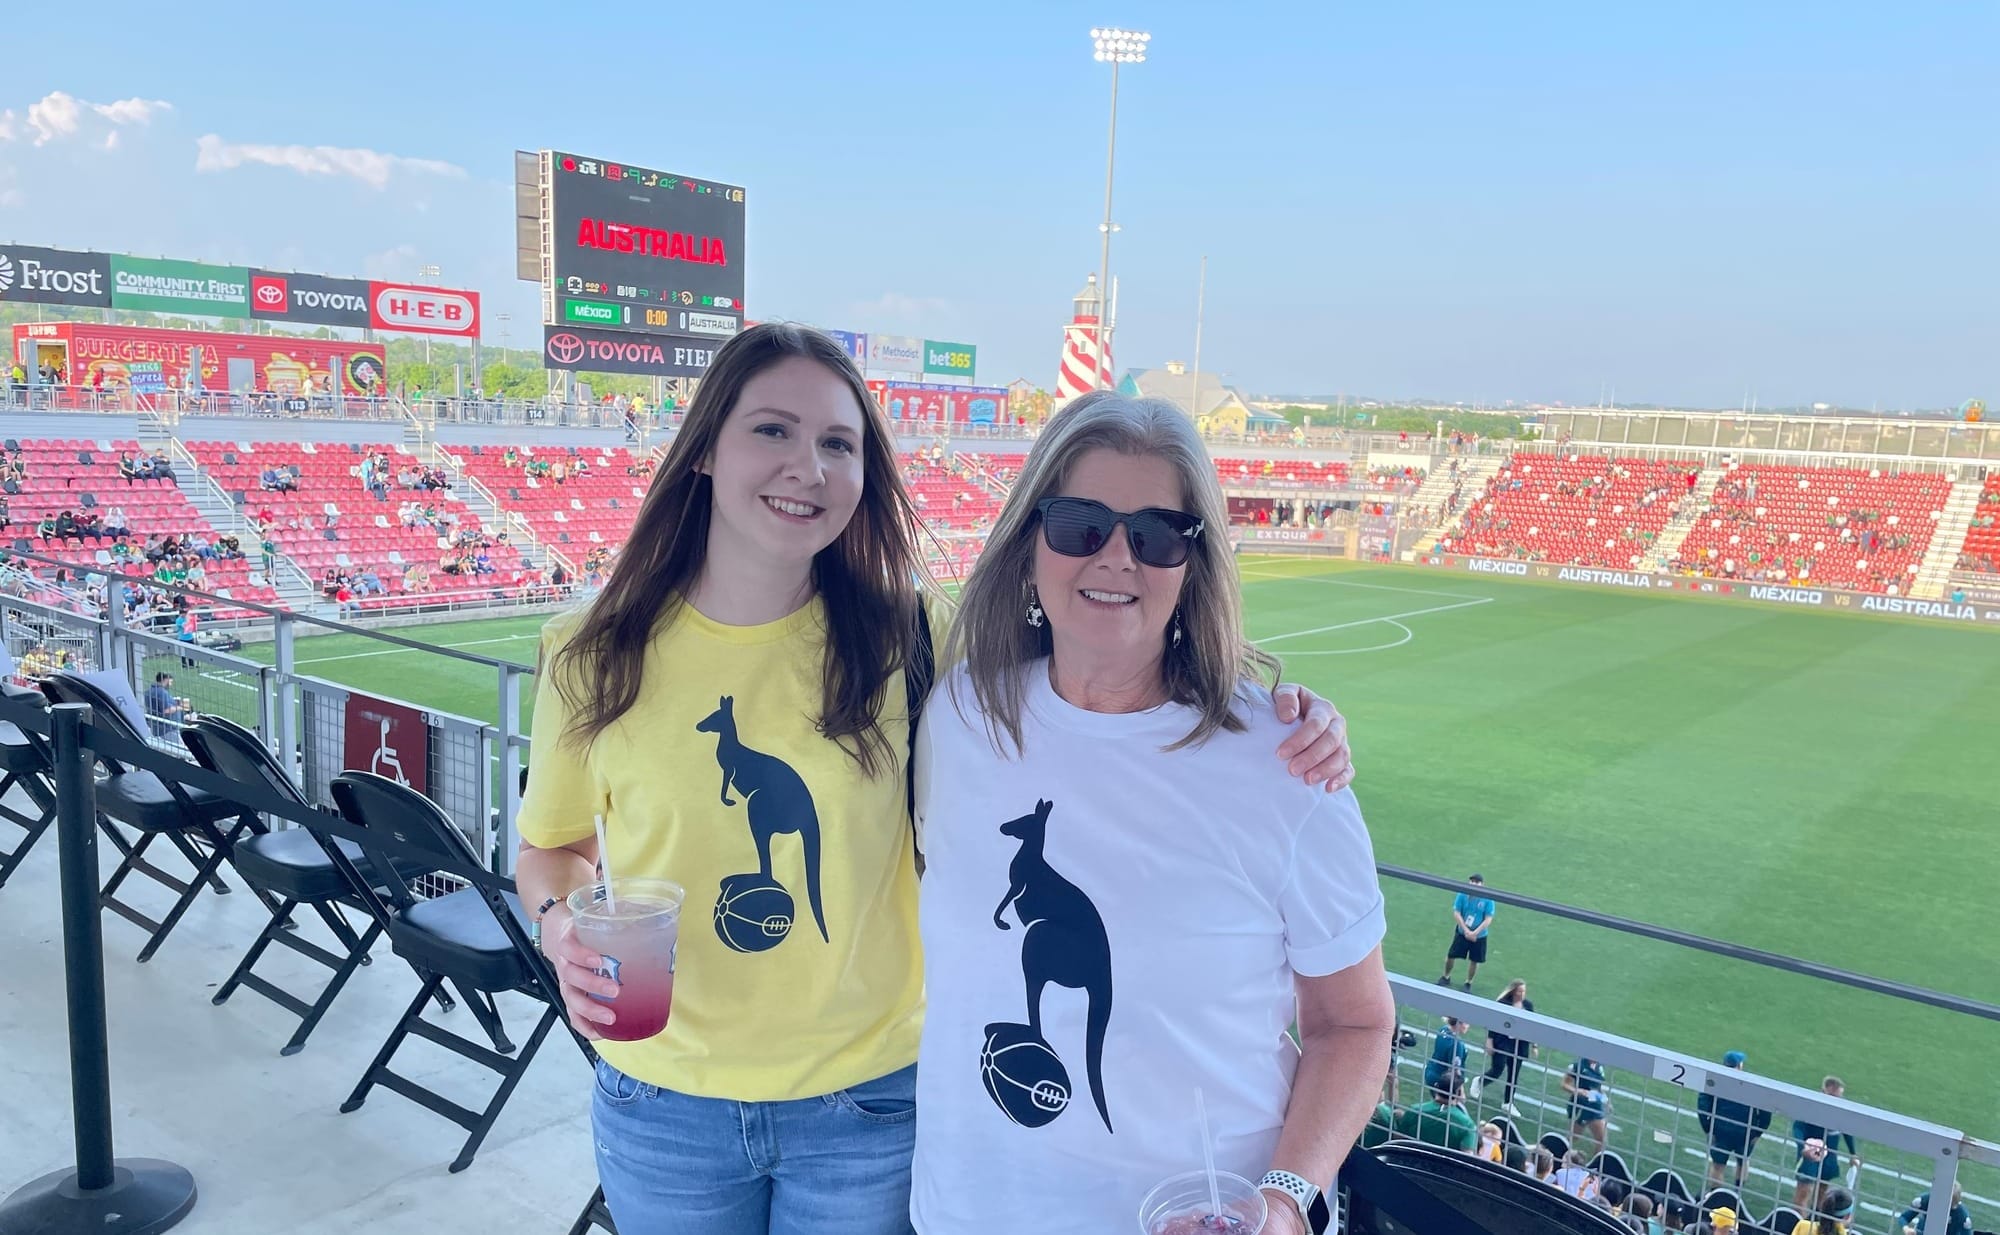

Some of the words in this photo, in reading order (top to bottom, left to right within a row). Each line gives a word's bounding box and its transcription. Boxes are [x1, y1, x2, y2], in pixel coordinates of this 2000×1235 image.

[578, 217, 727, 267] AUSTRALIA
[19, 259, 102, 295] Frost
[116, 271, 204, 293] COMMUNITY
[208, 280, 245, 296] FIRST
[137, 287, 183, 297] HEALTH
[190, 292, 227, 300] PLANS
[293, 290, 367, 312] TOYOTA
[574, 305, 612, 319] MÉXICO
[624, 306, 631, 324] 0
[646, 309, 668, 326] 0:00
[680, 312, 686, 329] 0
[690, 317, 736, 331] AUSTRALIA
[75, 336, 219, 364] BURGERTEA
[587, 340, 664, 364] TOYOTA
[882, 345, 919, 359] Methodist
[929, 349, 971, 368] bet365
[1469, 559, 1527, 575] MÉXICO
[1536, 566, 1550, 576] VS
[1558, 568, 1650, 587] AUSTRALIA
[1750, 585, 1822, 604] MÉXICO
[1834, 594, 1851, 606] VS
[1862, 596, 1976, 620] AUSTRALIA
[433, 716, 440, 726] 6
[1671, 1064, 1686, 1086] 2
